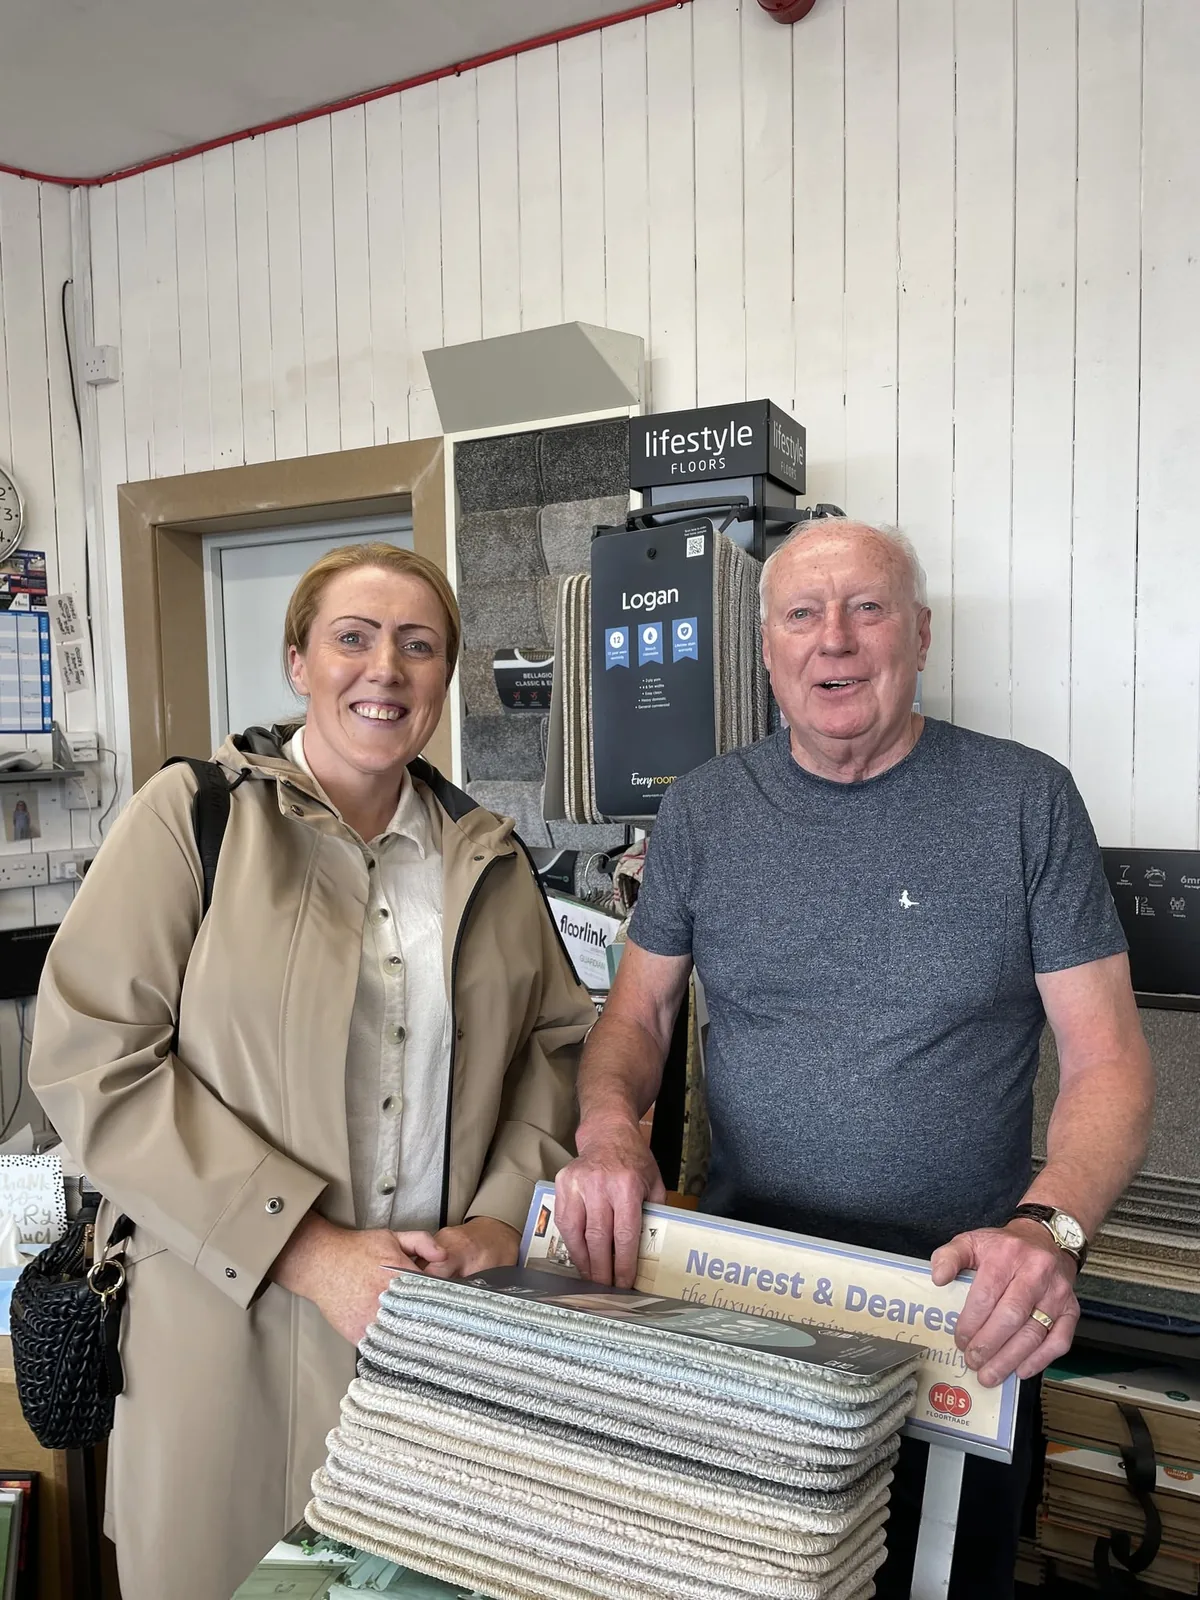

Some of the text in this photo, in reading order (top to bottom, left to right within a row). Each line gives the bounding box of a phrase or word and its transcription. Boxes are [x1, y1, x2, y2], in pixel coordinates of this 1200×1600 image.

[645, 420, 753, 456] lifestyle
[773, 420, 804, 466] lifestyle
[671, 457, 726, 475] FLOORS
[780, 461, 797, 480] FLOORS
[4, 507, 13, 521] 3
[622, 588, 679, 612] Logan
[612, 636, 621, 645] 12
[1119, 865, 1131, 879] 7
[560, 915, 607, 948] floorlink
[685, 1249, 960, 1336] Nearest & Deares
[681, 1282, 707, 1304] the
[711, 1288, 793, 1323] luxurious
[934, 1391, 966, 1409] HBS
[925, 1409, 970, 1427] FLOORTRADE
